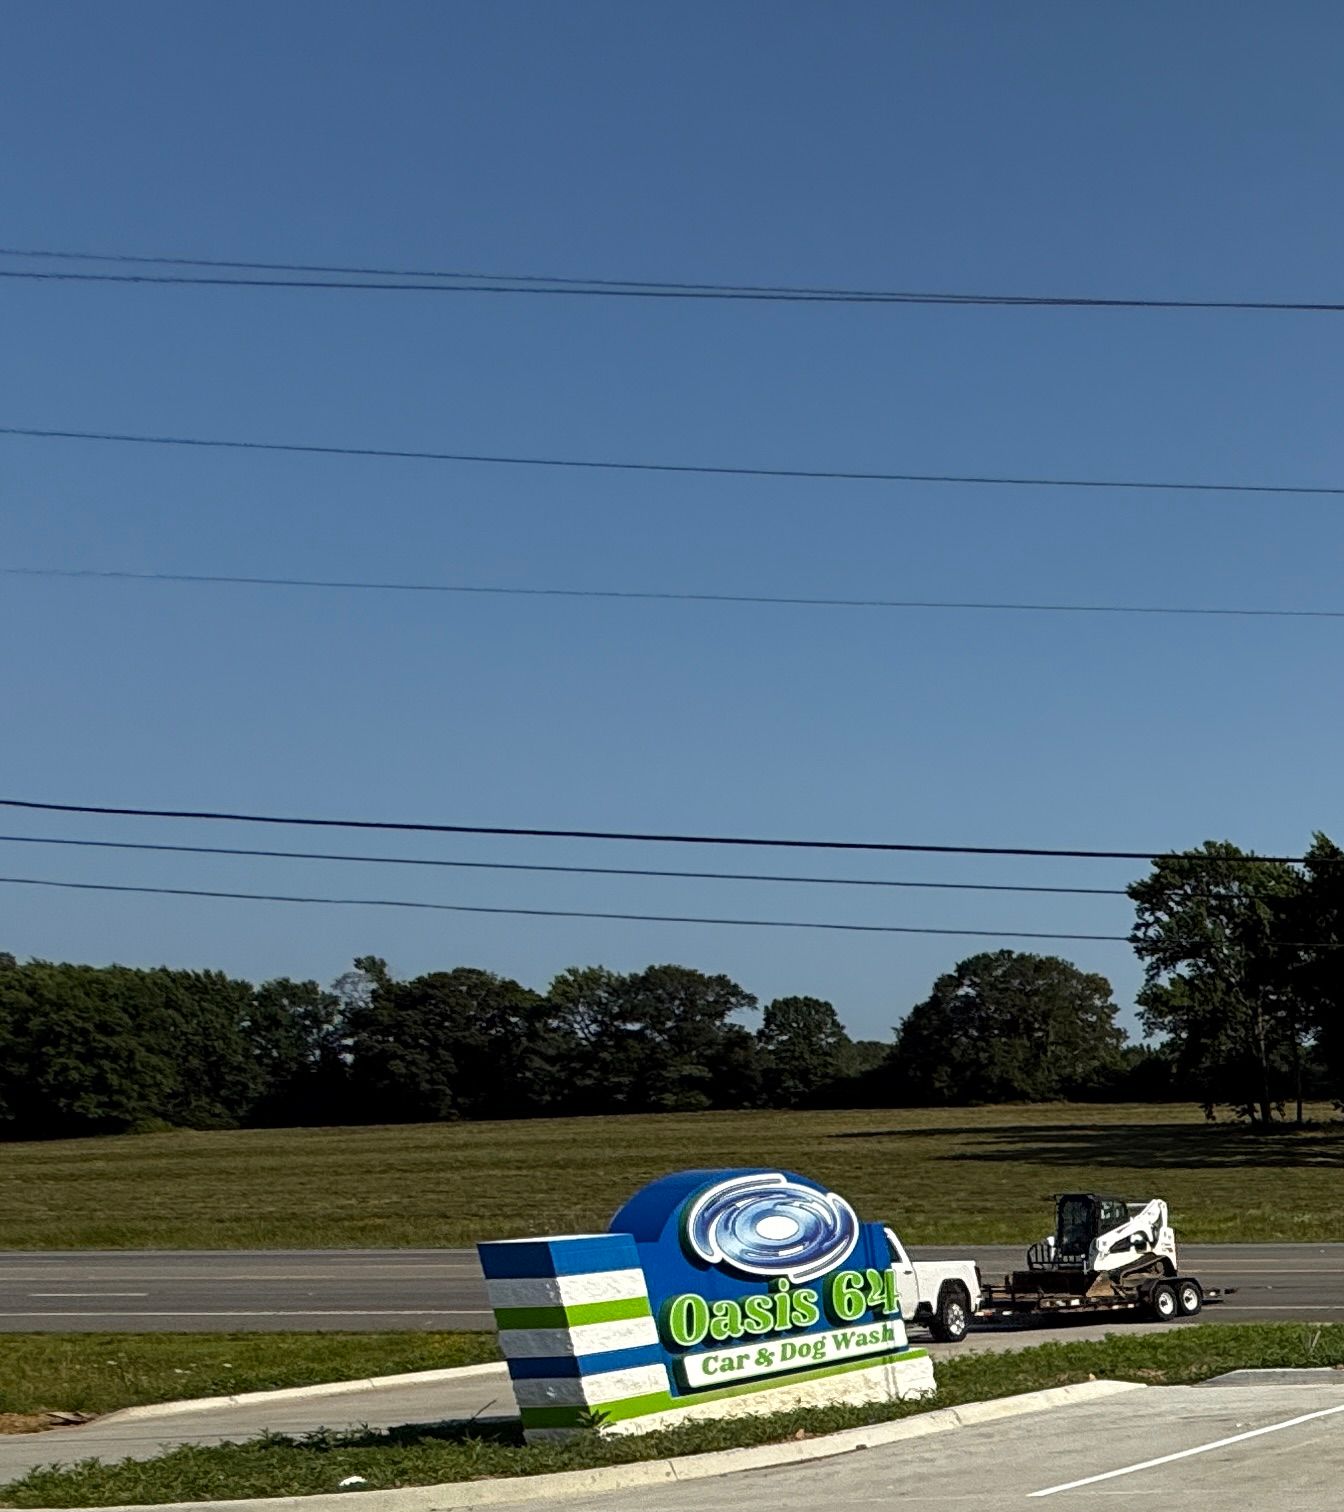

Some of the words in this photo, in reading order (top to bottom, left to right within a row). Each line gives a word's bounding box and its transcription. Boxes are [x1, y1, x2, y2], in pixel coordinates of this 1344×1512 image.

[670, 1278, 820, 1346] Oasis
[832, 1269, 899, 1321] 64
[702, 1353, 750, 1375] Car
[754, 1347, 775, 1367] &
[780, 1335, 827, 1360] Dog
[832, 1324, 895, 1351] Wash
